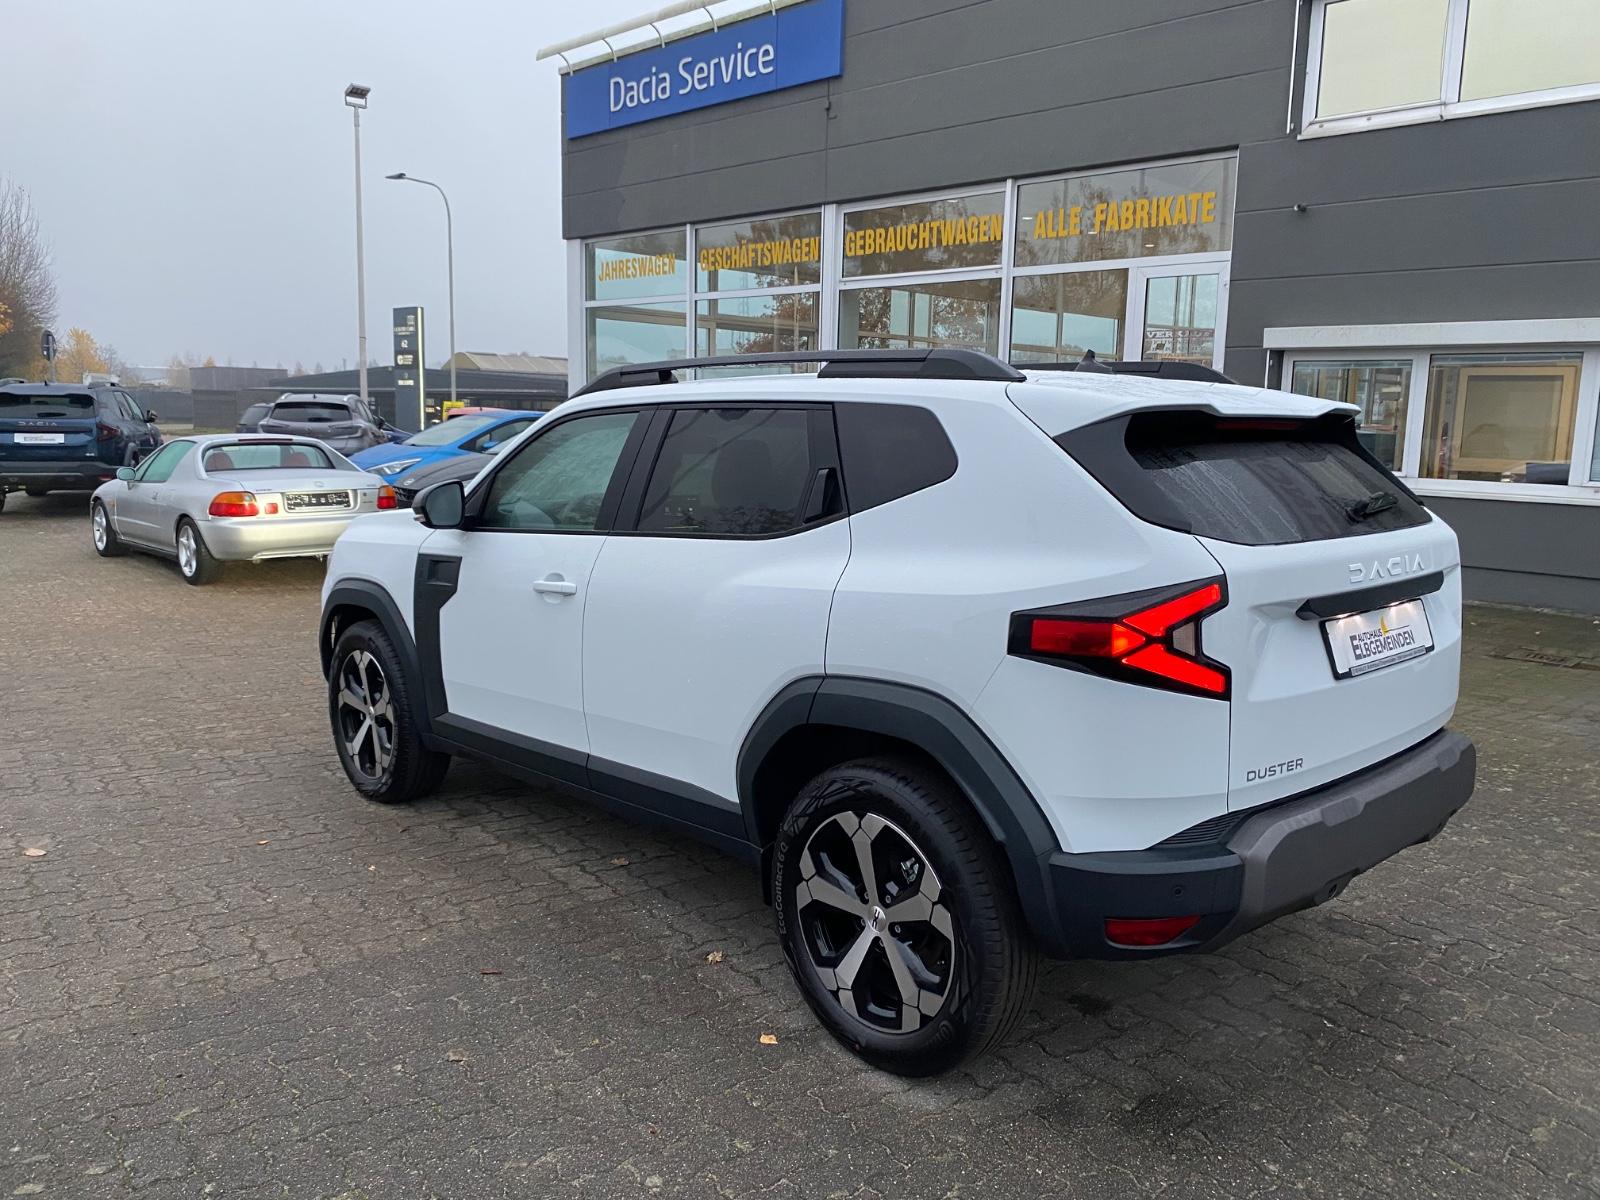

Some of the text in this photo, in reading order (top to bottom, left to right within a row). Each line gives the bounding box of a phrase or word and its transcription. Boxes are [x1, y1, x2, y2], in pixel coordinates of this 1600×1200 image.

[609, 42, 775, 112] Dacia Service
[1033, 191, 1216, 240] ALLE FABRIKATE
[844, 213, 1003, 257] GEBRAUCHTWAGEN
[598, 253, 676, 283] JAHRESWAGEN
[700, 236, 821, 272] GESCHÄFTSWAGEN
[1348, 553, 1425, 584] DACIA
[1349, 629, 1416, 661] ELBGEMEINDEN
[1357, 628, 1383, 643] AUTOHAUS
[1246, 757, 1304, 783] DUSTER
